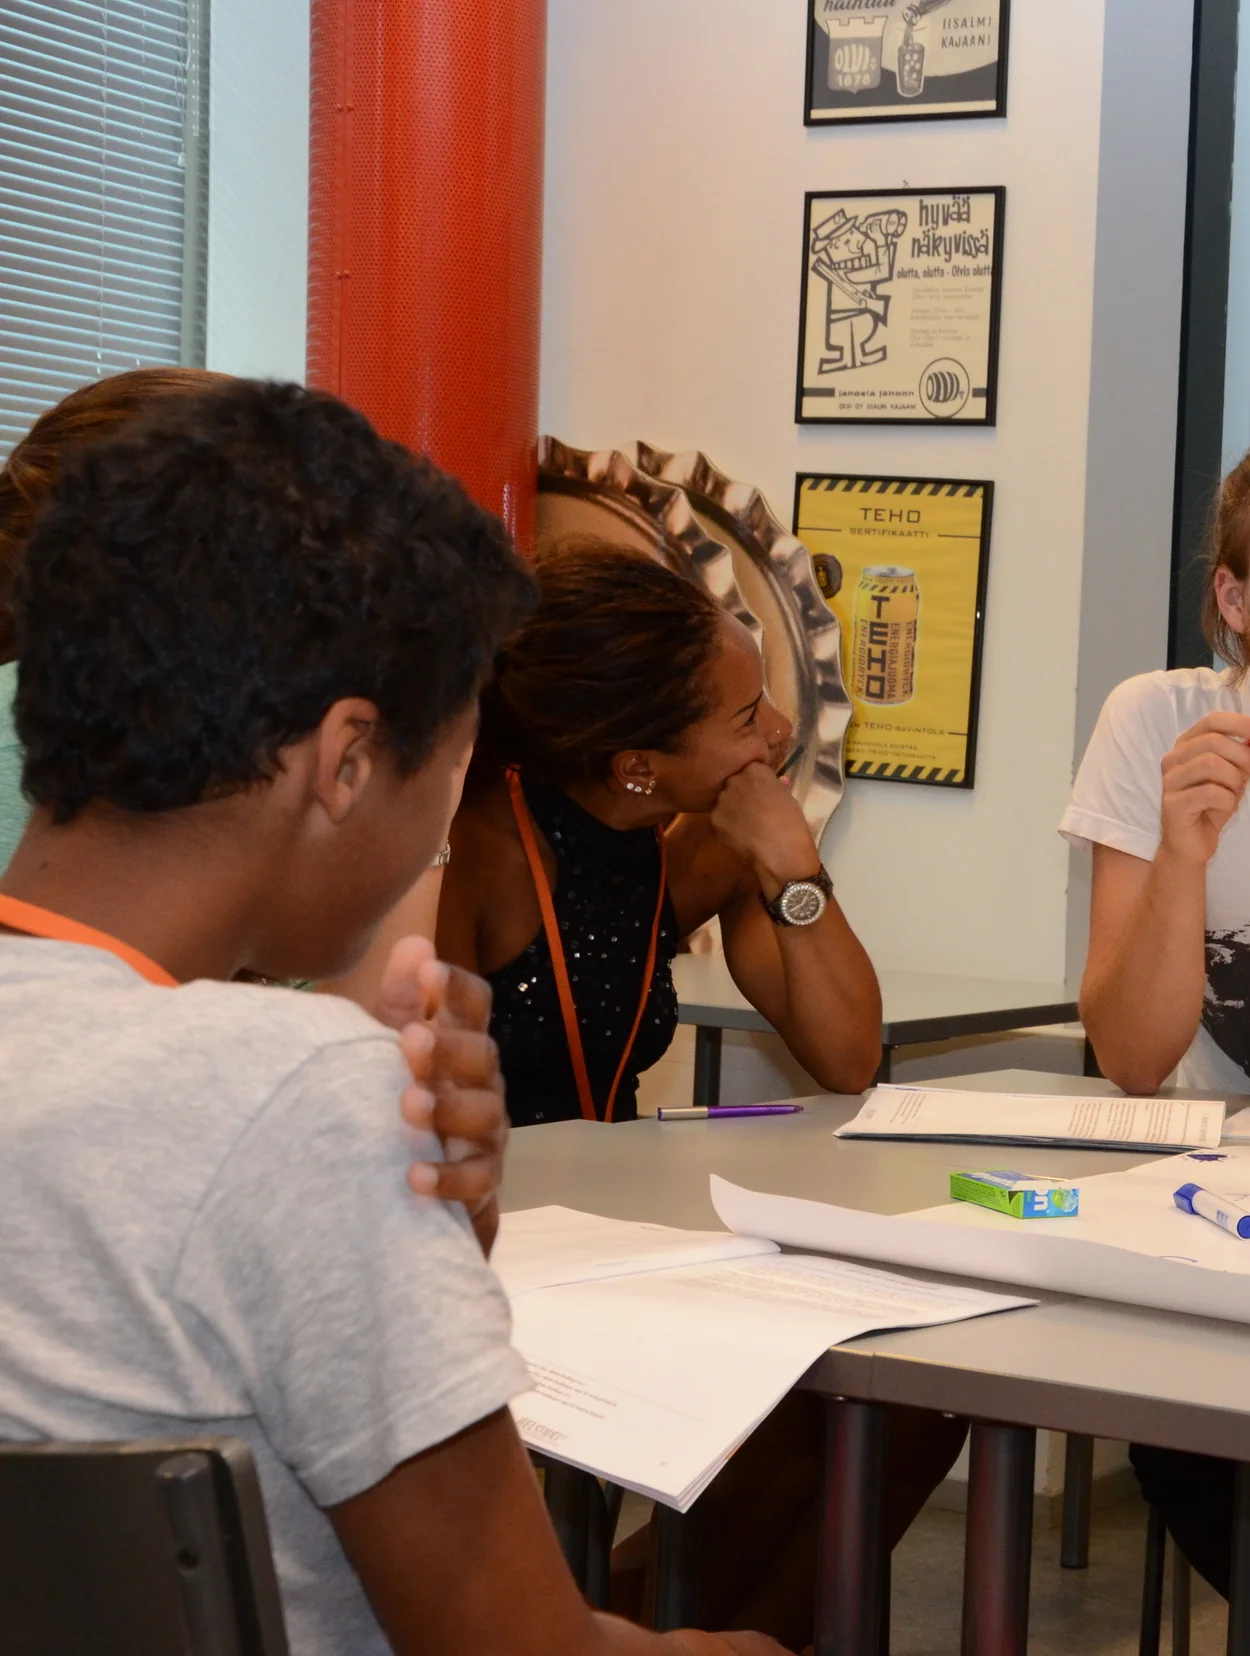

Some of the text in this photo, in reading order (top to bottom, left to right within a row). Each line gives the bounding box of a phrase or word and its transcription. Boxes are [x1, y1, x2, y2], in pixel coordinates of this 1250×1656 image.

[943, 17, 992, 30] IISALMI
[941, 34, 991, 49] KAJAANI
[836, 73, 870, 87] 1878
[919, 194, 971, 231] hyvää
[911, 228, 989, 263] näkyvissä
[860, 507, 921, 524] TEHO
[849, 527, 929, 539] SERTIFIKAATTI
[865, 594, 890, 700] TEHO
[887, 622, 901, 699] ENERGIAJUOMA
[864, 722, 945, 736] TEHO-RAVINTOLA
